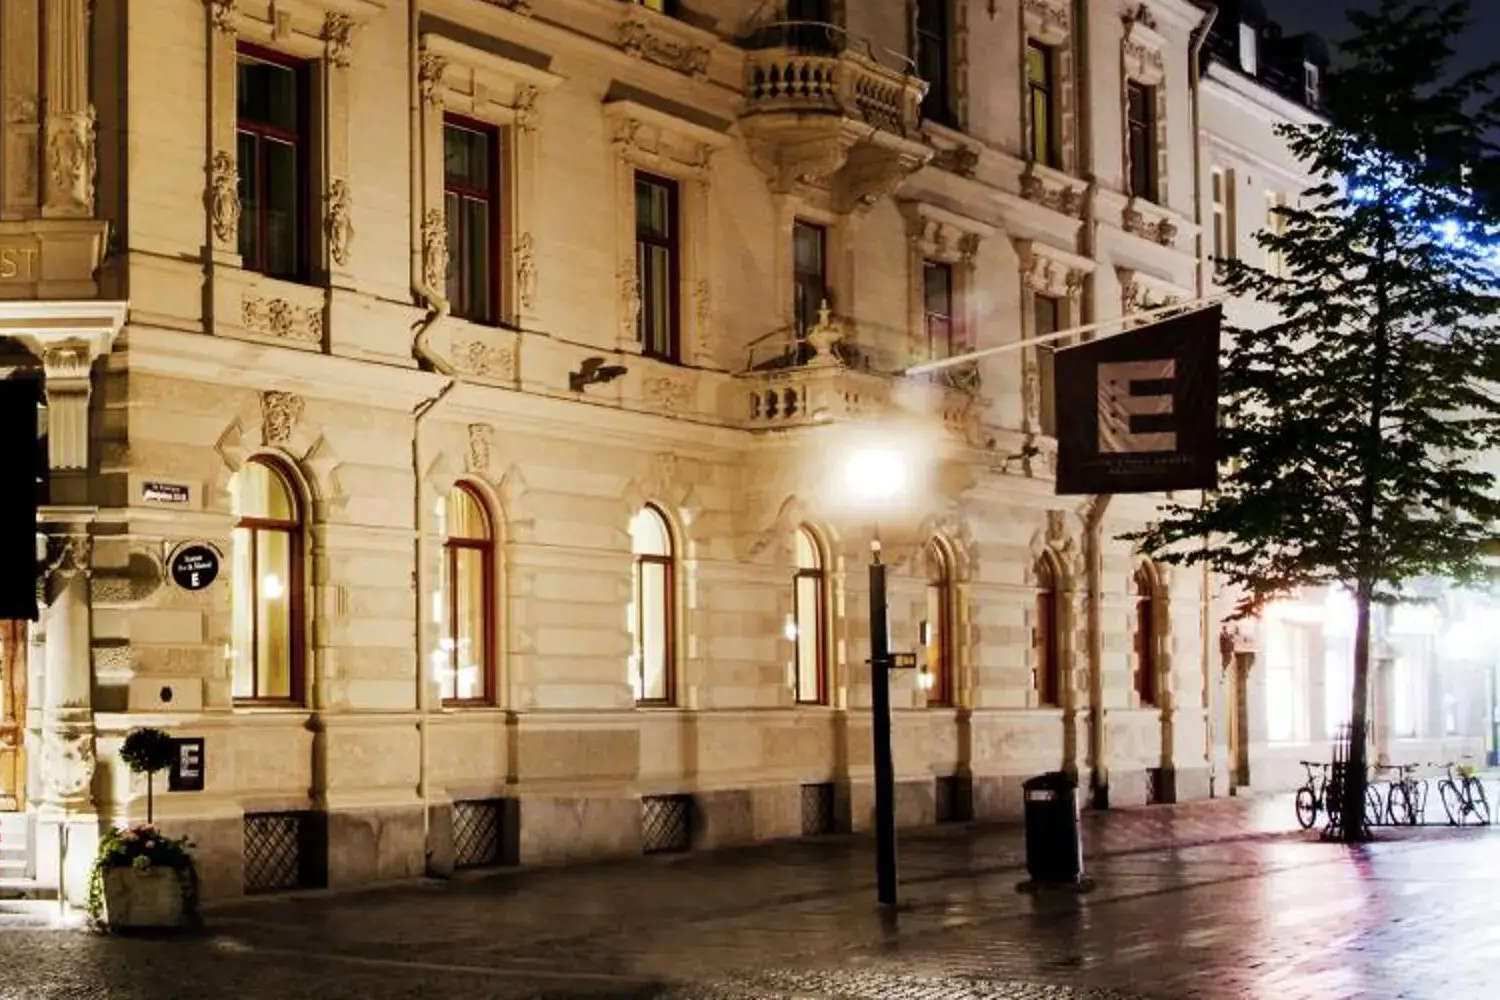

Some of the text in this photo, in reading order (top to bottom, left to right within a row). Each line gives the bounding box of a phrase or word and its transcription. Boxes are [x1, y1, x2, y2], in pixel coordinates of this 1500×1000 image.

[1098, 359, 1177, 452] E
[191, 572, 200, 587] E
[180, 744, 200, 777] E
